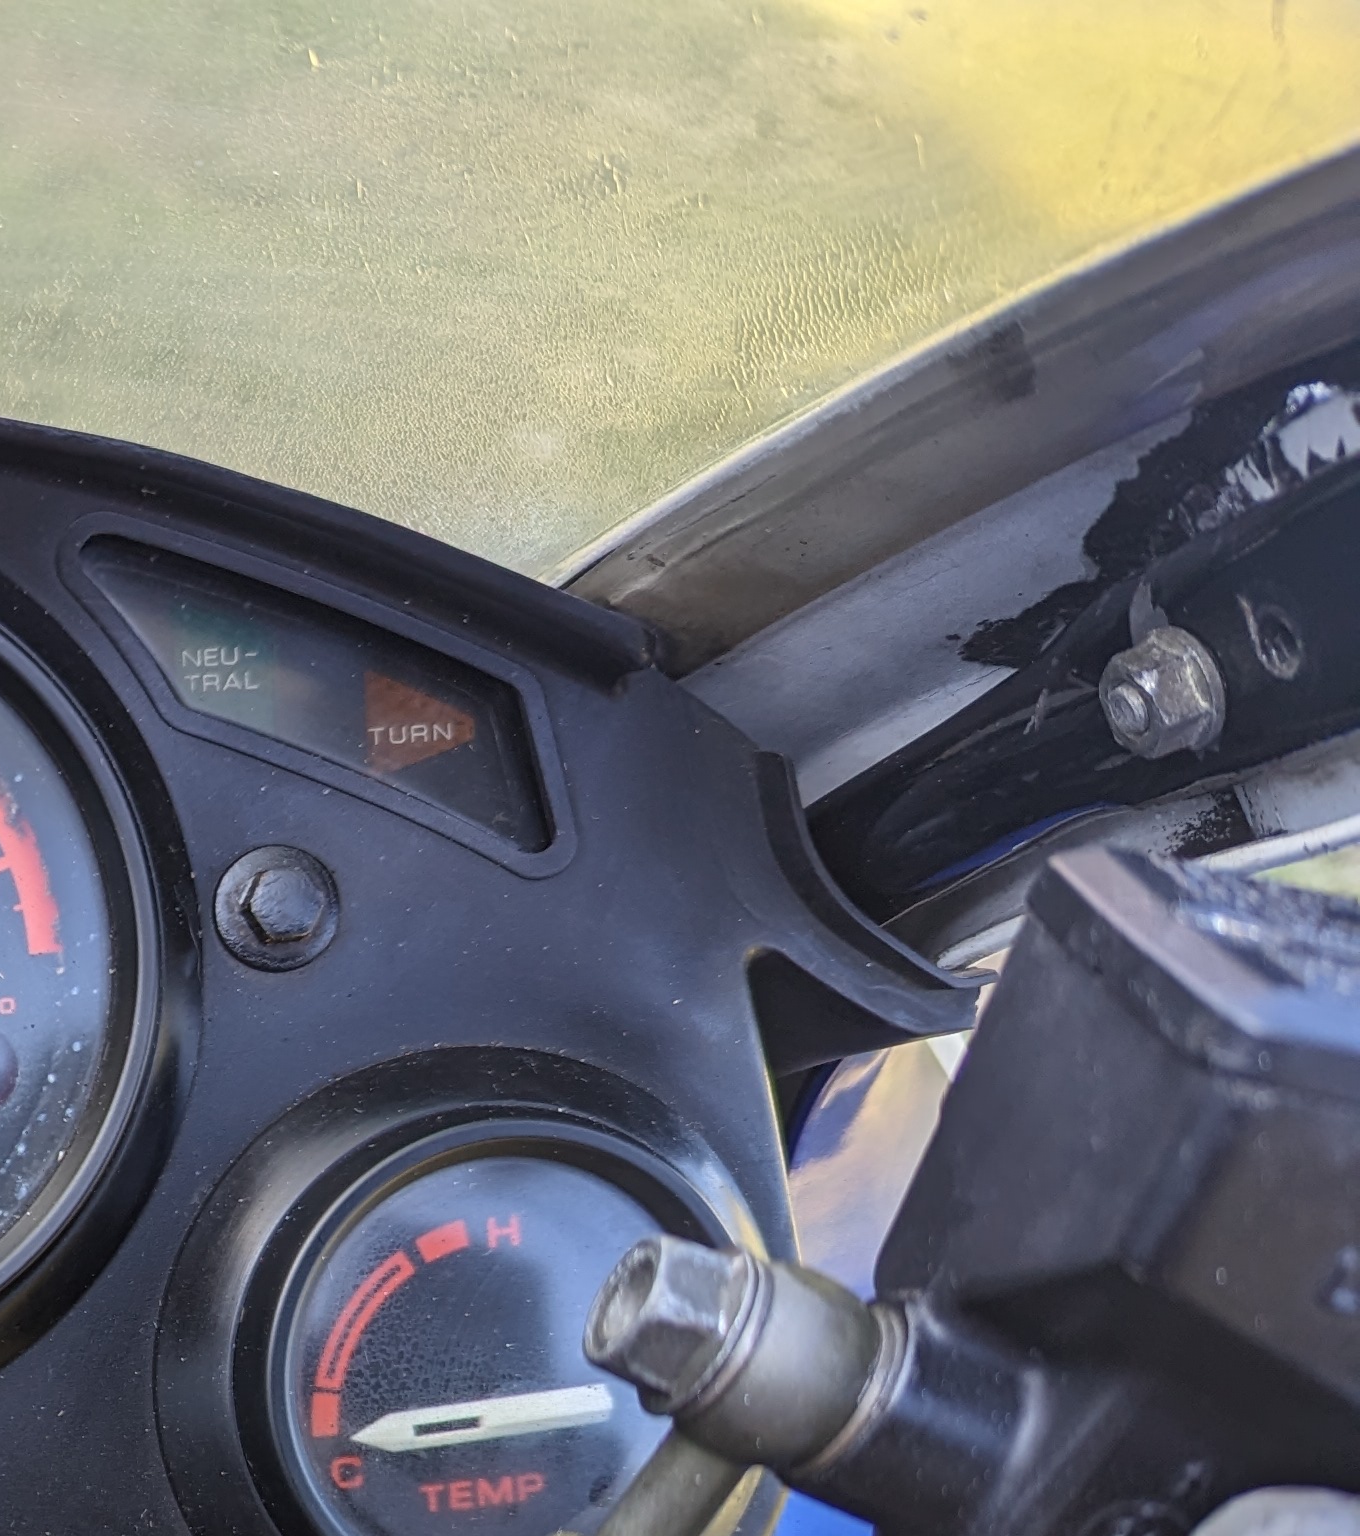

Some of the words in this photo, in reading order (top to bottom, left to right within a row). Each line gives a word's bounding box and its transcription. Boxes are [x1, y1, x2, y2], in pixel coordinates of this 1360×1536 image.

[185, 673, 259, 692] TRAL
[368, 722, 455, 746] TURN
[487, 1214, 522, 1248] H
[331, 1456, 363, 1489] C
[420, 1472, 544, 1511] TEMP
